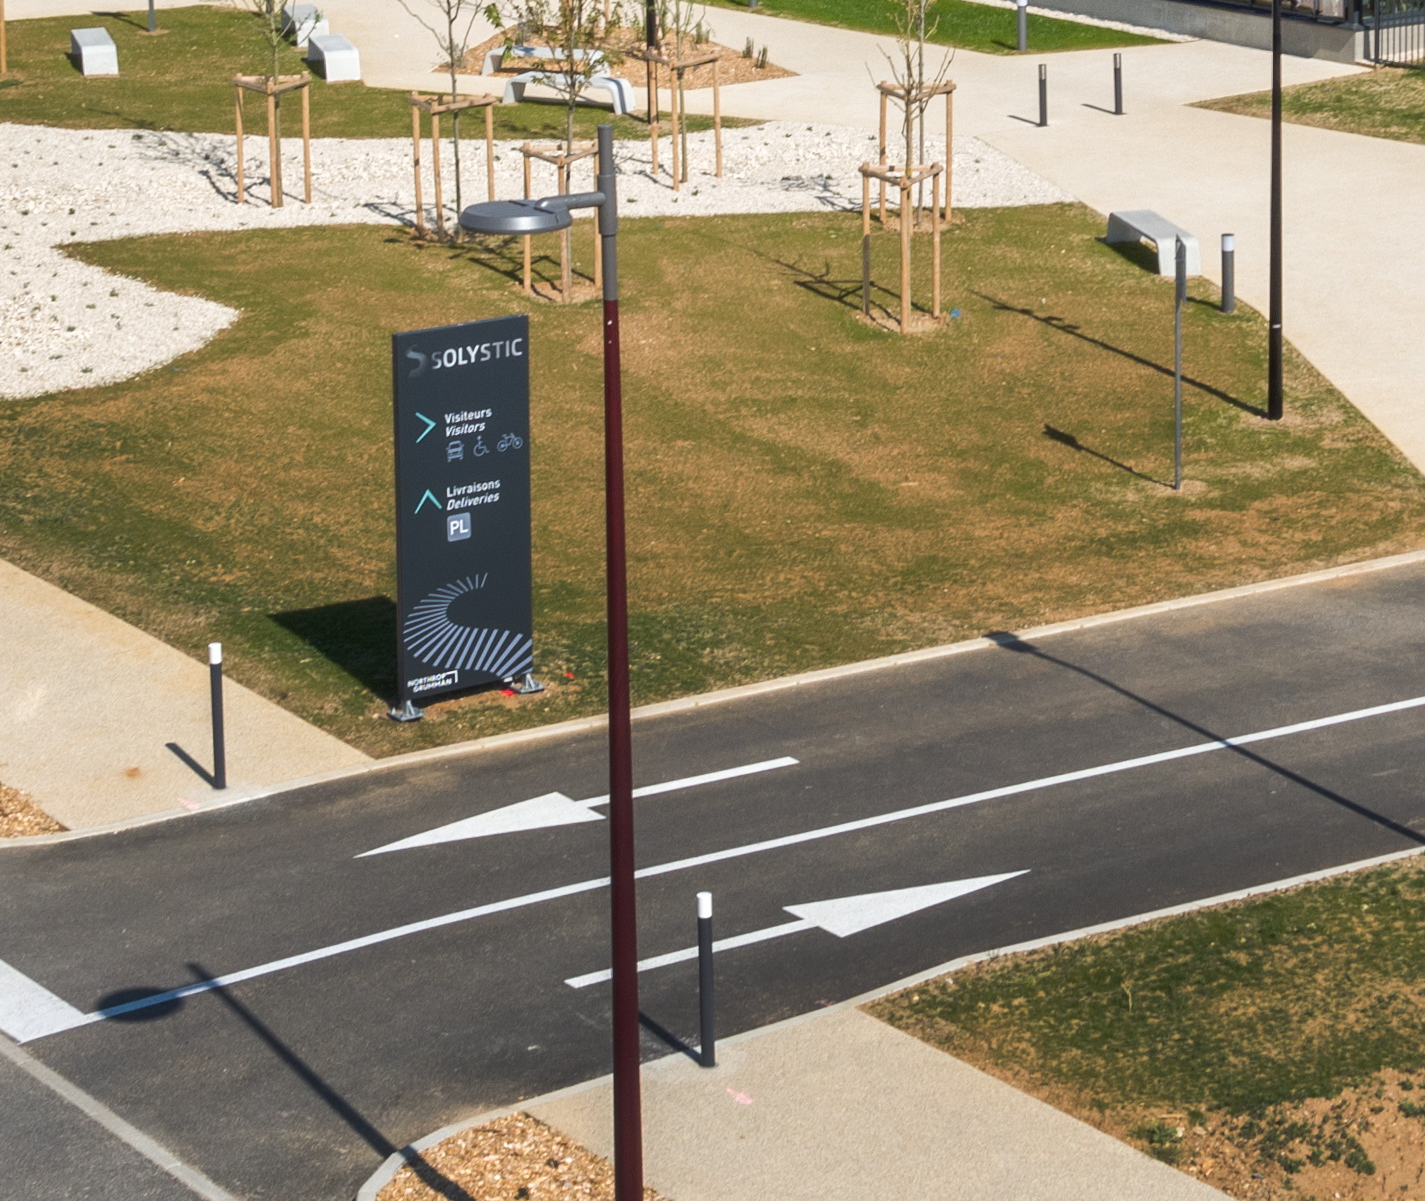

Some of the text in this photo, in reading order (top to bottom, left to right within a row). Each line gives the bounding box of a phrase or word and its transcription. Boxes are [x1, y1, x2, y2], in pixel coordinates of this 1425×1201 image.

[431, 338, 523, 369] SOLYSTIC
[444, 408, 493, 424] Visiteurs
[445, 422, 486, 437] Visitors
[446, 480, 501, 498] Livraisons
[446, 492, 500, 511] Deliveries
[450, 519, 469, 536] PL
